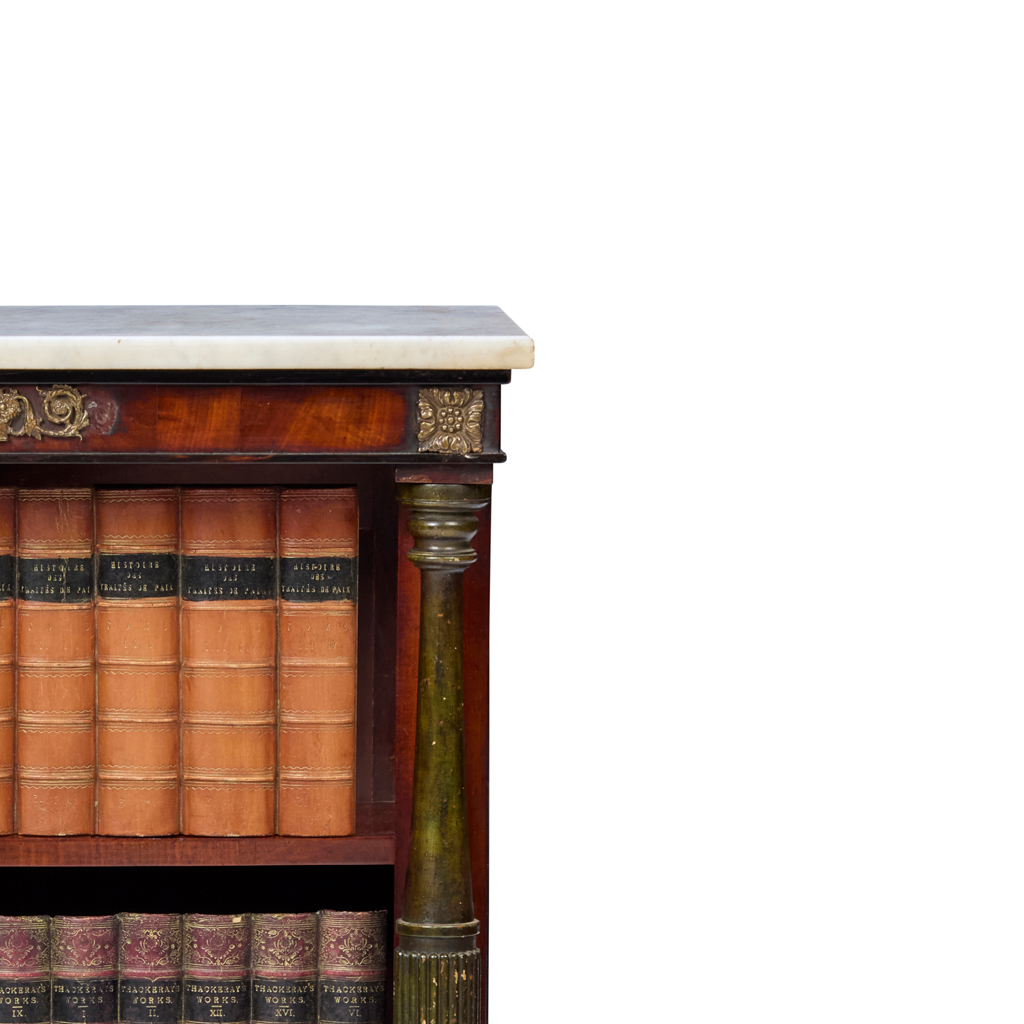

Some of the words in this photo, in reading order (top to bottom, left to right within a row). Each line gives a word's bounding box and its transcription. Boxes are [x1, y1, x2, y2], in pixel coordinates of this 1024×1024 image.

[121, 981, 181, 994] THACKERAY'S
[185, 981, 247, 994] THACKERAY'S
[254, 982, 315, 994] THACKERAY'S
[323, 983, 385, 994] THACKERAY'S
[132, 996, 173, 1005] WORKS.
[196, 996, 239, 1004] WORKS.
[264, 996, 306, 1005] WORKS.
[11, 1009, 27, 1018] IX.
[147, 1009, 159, 1018] II.
[209, 1009, 226, 1017] XII.
[274, 1009, 296, 1018] XVI.
